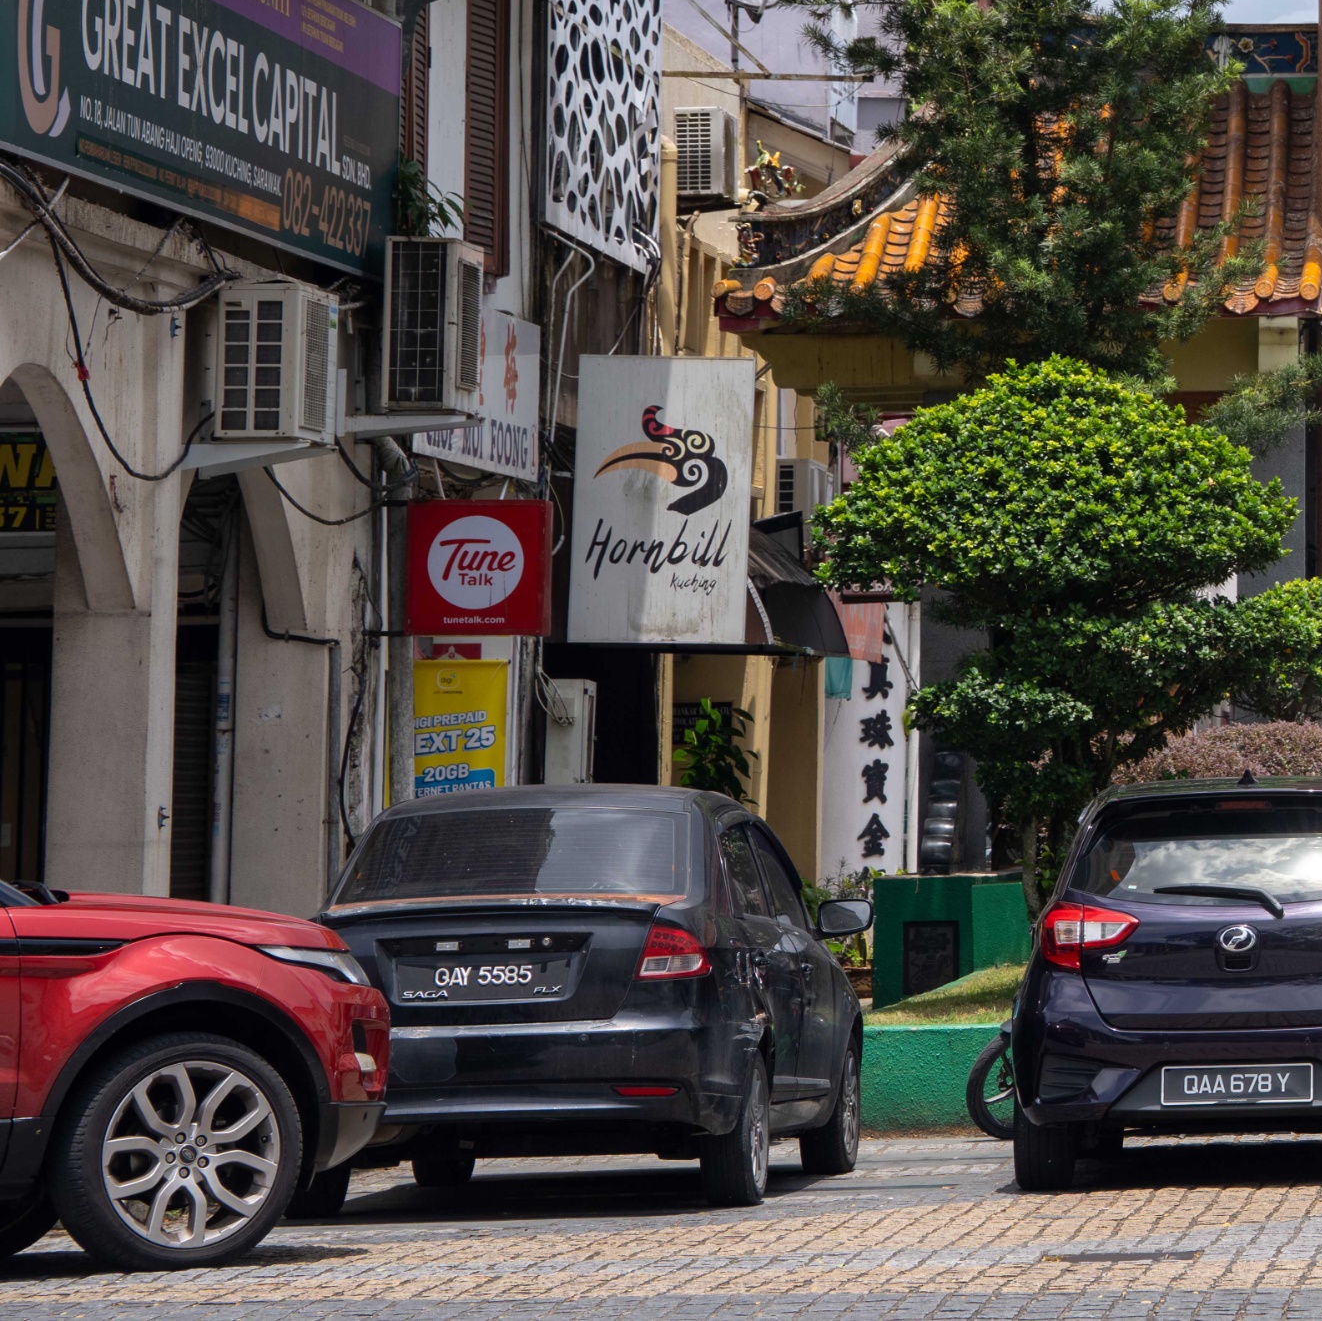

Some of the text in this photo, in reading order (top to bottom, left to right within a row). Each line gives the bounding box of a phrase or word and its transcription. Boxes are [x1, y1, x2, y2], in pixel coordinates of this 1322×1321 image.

[178, 15, 248, 135] EXCEL
[252, 52, 340, 176] CAPITAL
[342, 155, 356, 182] SDN.
[357, 162, 372, 191] BHD.
[80, 95, 93, 122] NO.
[104, 105, 126, 135] JALAN
[127, 114, 141, 141] TUN
[141, 120, 165, 150] ABANG
[165, 129, 180, 156] HAJI
[181, 136, 203, 169] OPENG,
[205, 145, 224, 172] 93000
[224, 153, 252, 188] KUCHING,
[283, 167, 372, 259] 082-422337
[490, 419, 528, 470] FOONG
[439, 538, 515, 581] Tune
[585, 518, 732, 580] Hornbill
[458, 573, 493, 586] Talk
[670, 572, 717, 595] Kuching
[443, 615, 505, 625] tunetalk.com
[441, 675, 453, 685] digi
[433, 710, 488, 728] PREPAID
[414, 725, 496, 756] EXT 25
[857, 603, 894, 881] 真珠寶金
[423, 763, 471, 784] 20GB
[414, 784, 450, 799] TERNET
[434, 964, 533, 986] QAY 5585
[402, 989, 449, 999] SAGA
[533, 984, 563, 994] FLX
[1183, 1072, 1291, 1095] QAA 678 Y
